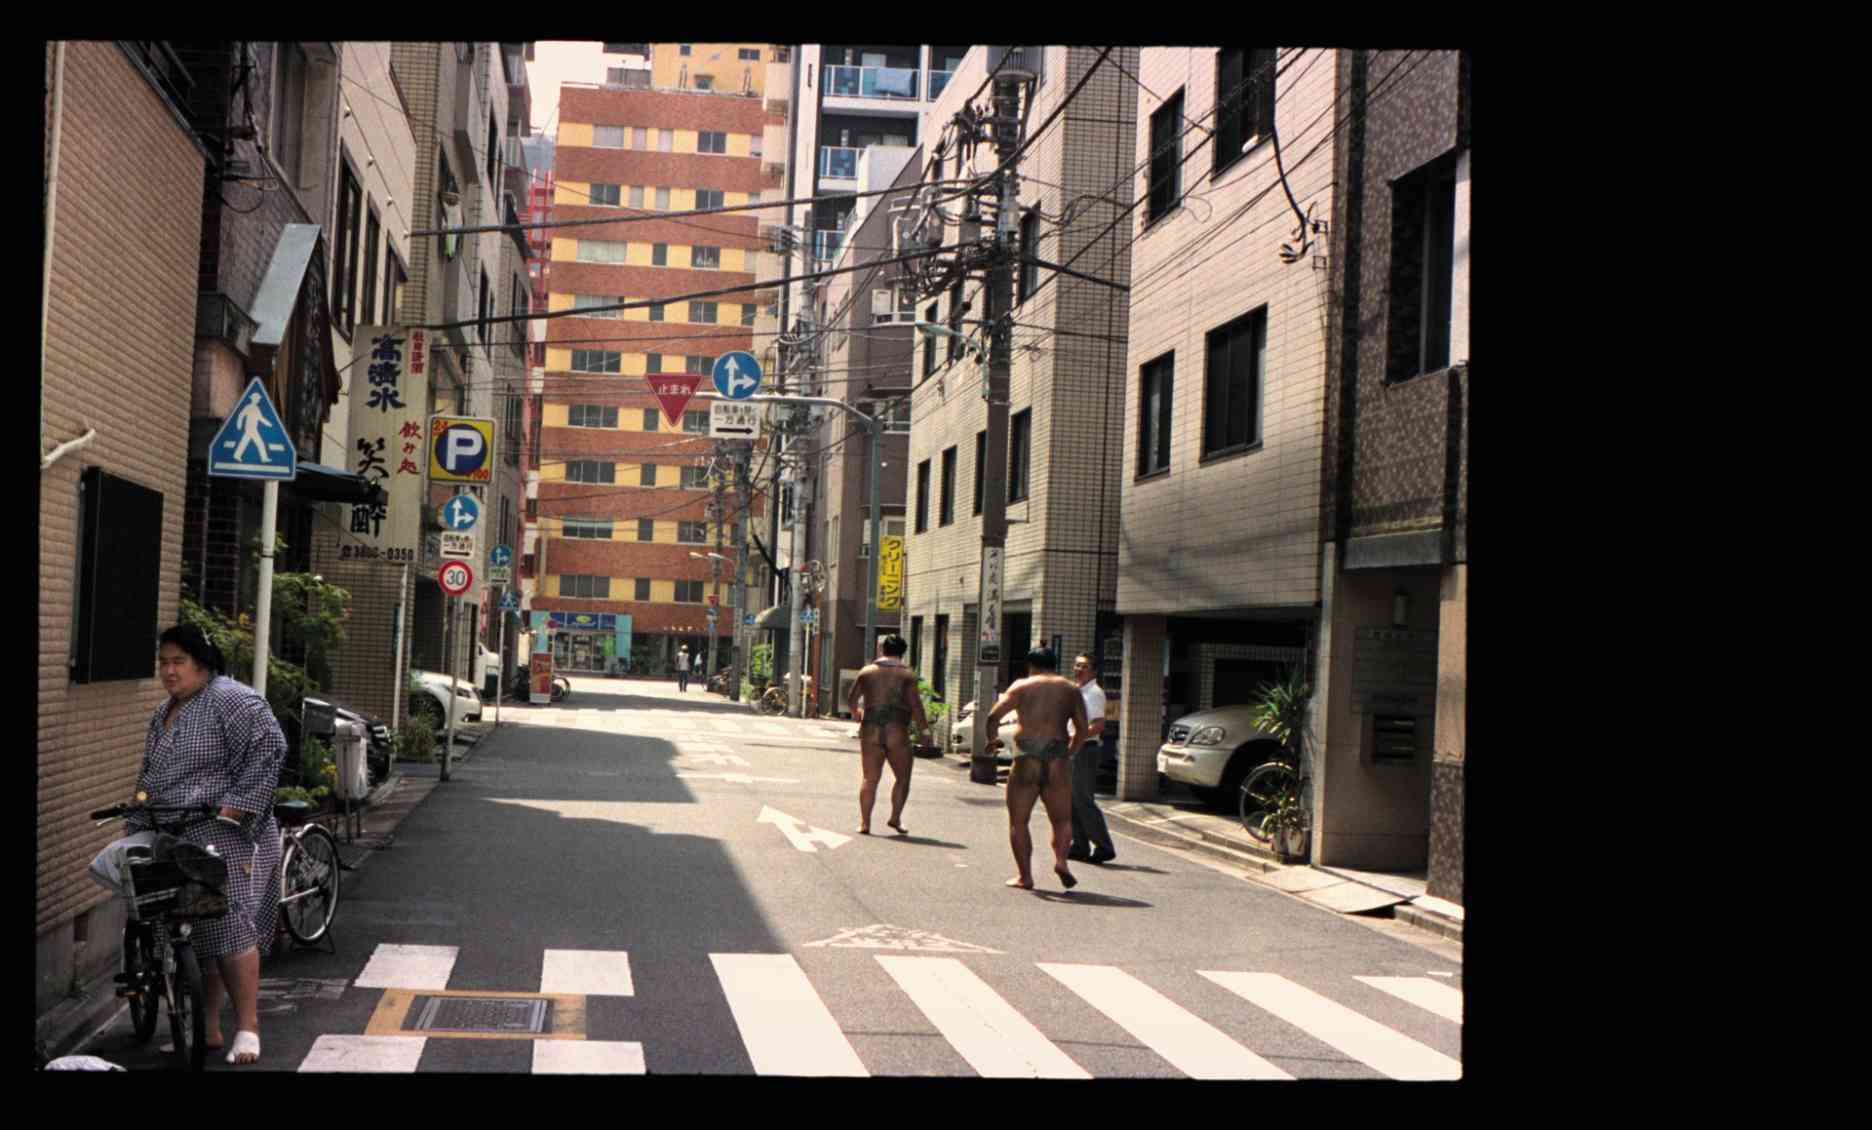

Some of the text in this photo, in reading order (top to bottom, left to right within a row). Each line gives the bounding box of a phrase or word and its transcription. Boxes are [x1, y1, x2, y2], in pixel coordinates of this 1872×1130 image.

[658, 384, 692, 395] 止まれ
[398, 421, 421, 475] 飲み処
[446, 429, 483, 470] P
[446, 570, 465, 586] 30
